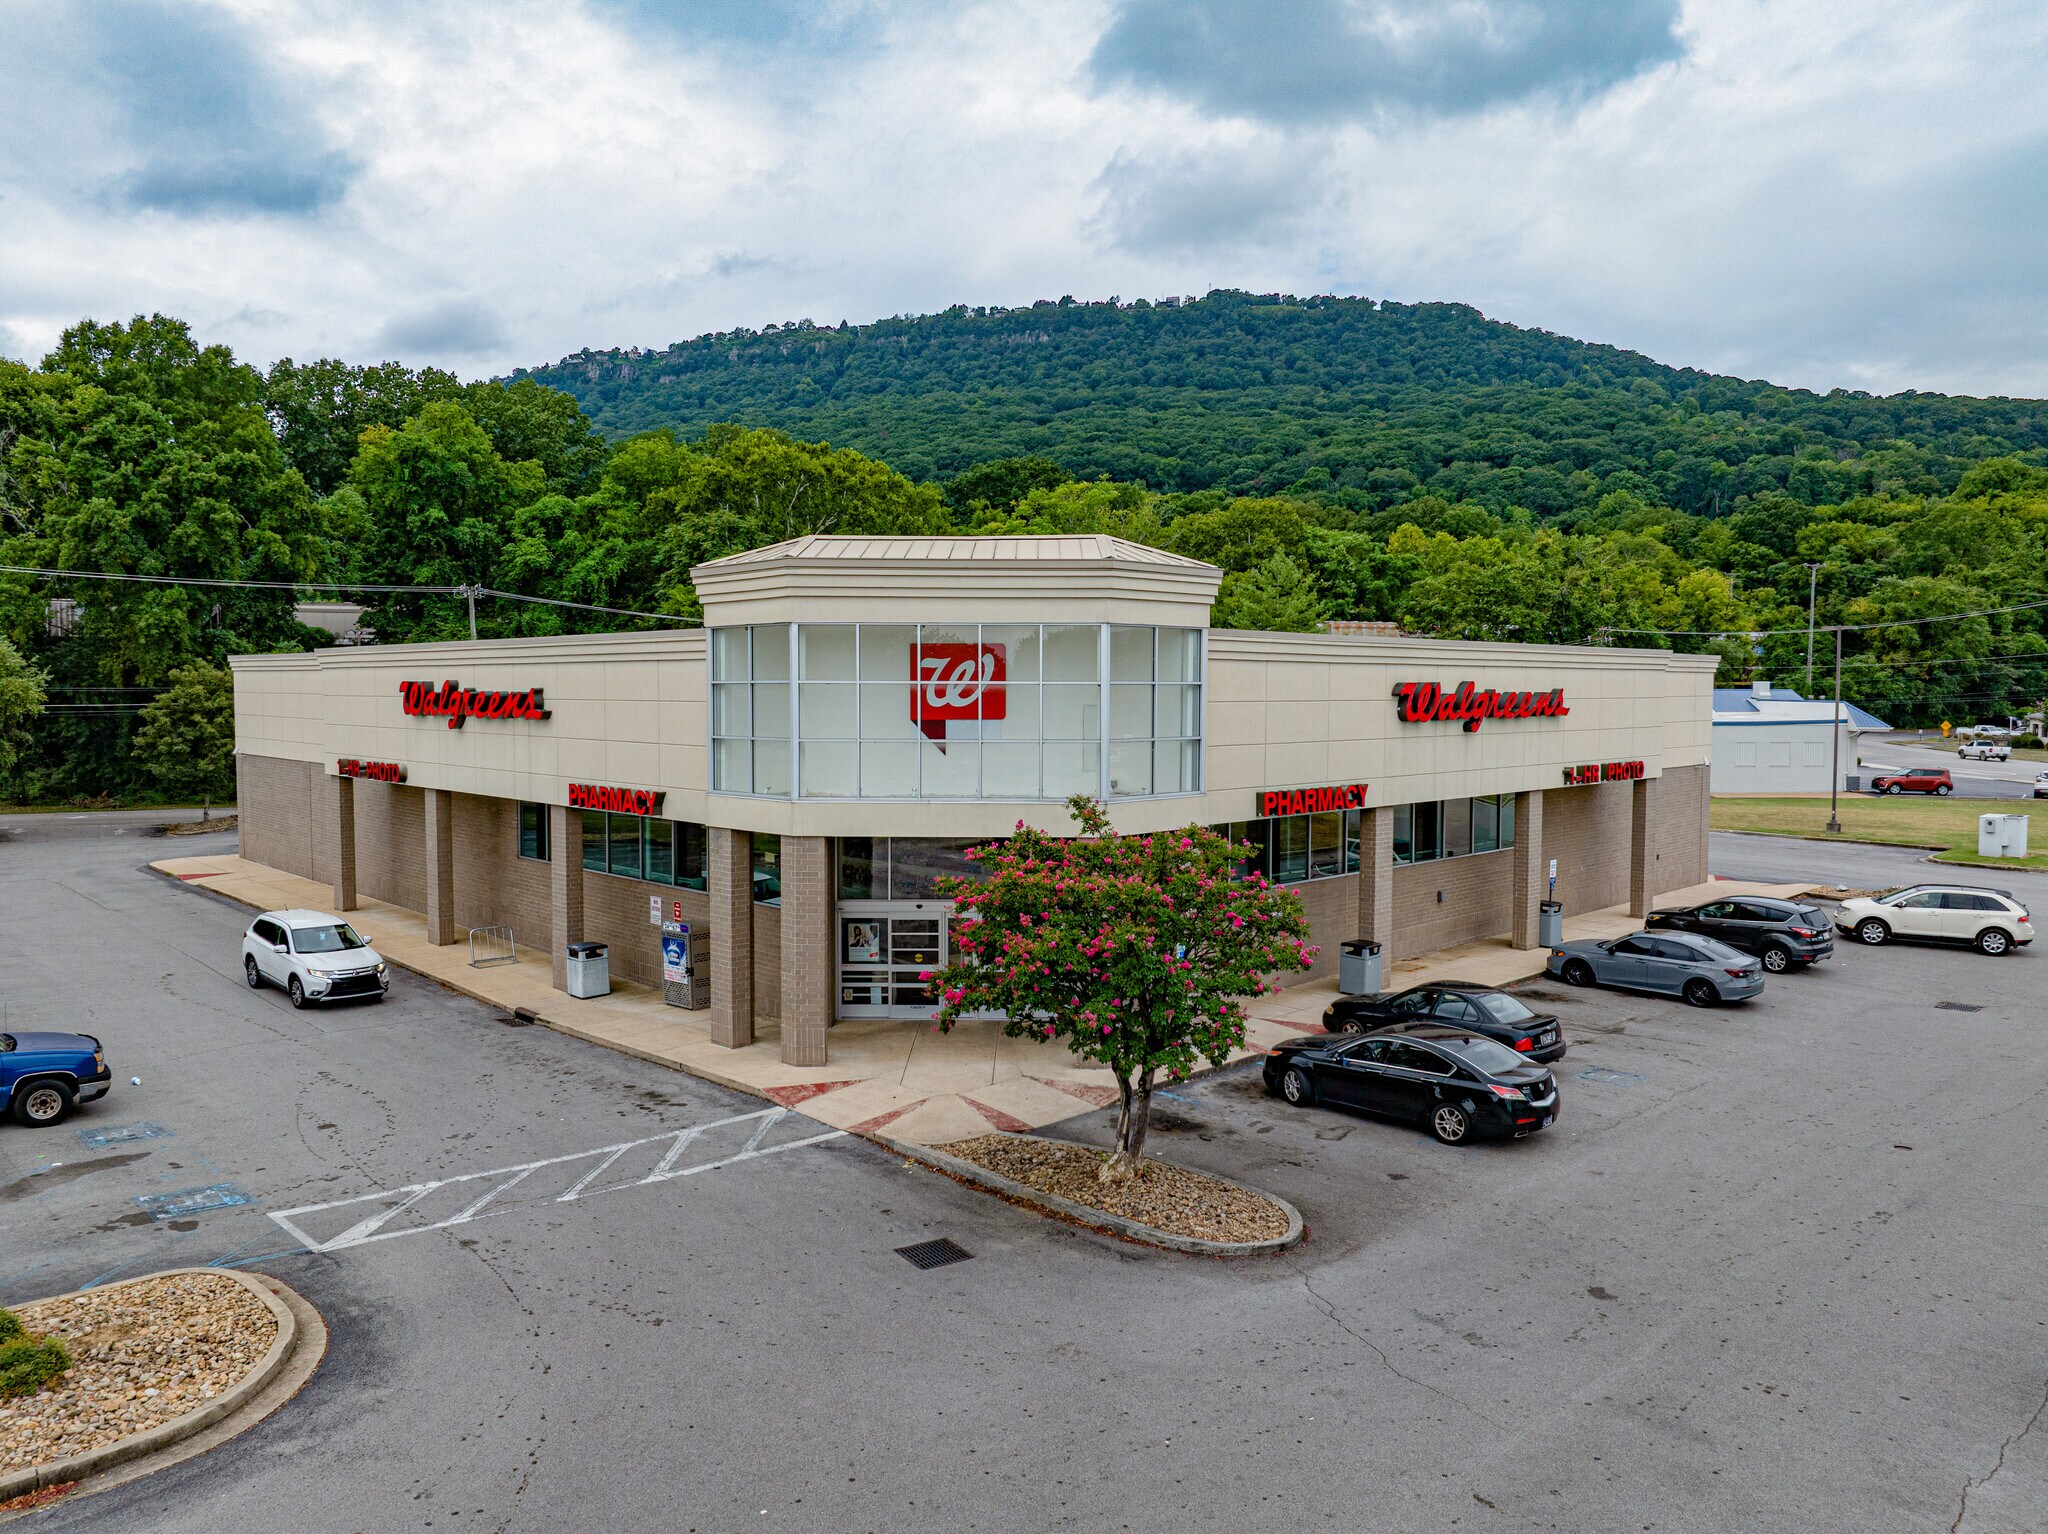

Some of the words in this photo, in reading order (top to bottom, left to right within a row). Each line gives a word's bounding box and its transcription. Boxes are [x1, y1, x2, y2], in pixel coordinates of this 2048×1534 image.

[400, 680, 543, 730] Walgreens
[1400, 680, 1570, 733] Walgreens
[337, 758, 361, 778] 1-HR
[366, 761, 400, 783] PHOTO
[1569, 764, 1599, 785] 1-HR
[1608, 760, 1645, 782] PHOTO
[568, 783, 657, 816] PHARMACY
[1263, 783, 1369, 817] PHARMACY
